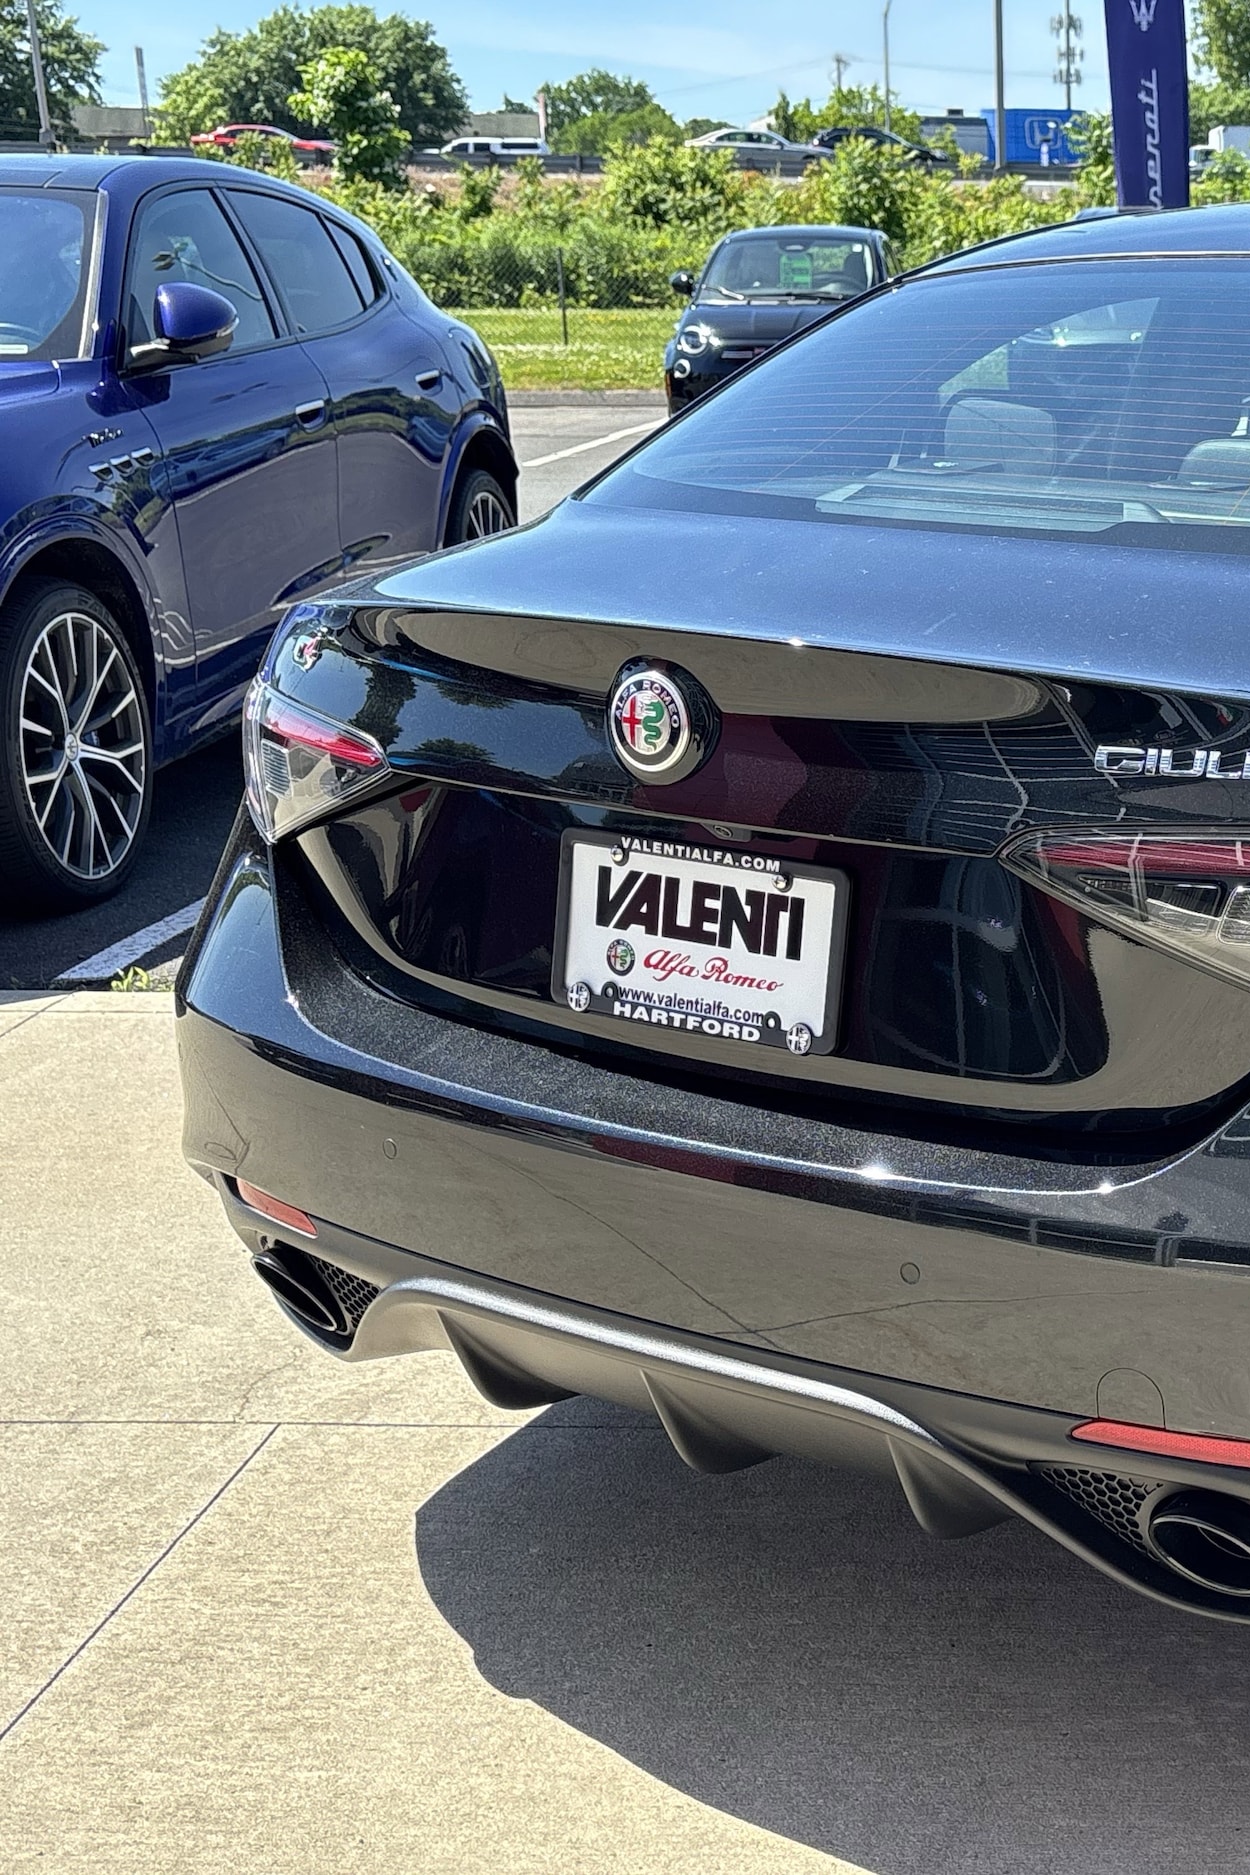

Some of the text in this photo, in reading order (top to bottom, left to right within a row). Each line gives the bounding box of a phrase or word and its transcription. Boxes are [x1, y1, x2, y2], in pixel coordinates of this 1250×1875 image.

[615, 680, 680, 728] ALFA ROMEO
[621, 836, 780, 873] VALENTIALFA.COM
[596, 865, 805, 961] VALENTI
[643, 949, 784, 991] Alfa Romeo
[613, 1001, 761, 1042] HARTFORD
[618, 986, 764, 1027] www.valentialfa.com
